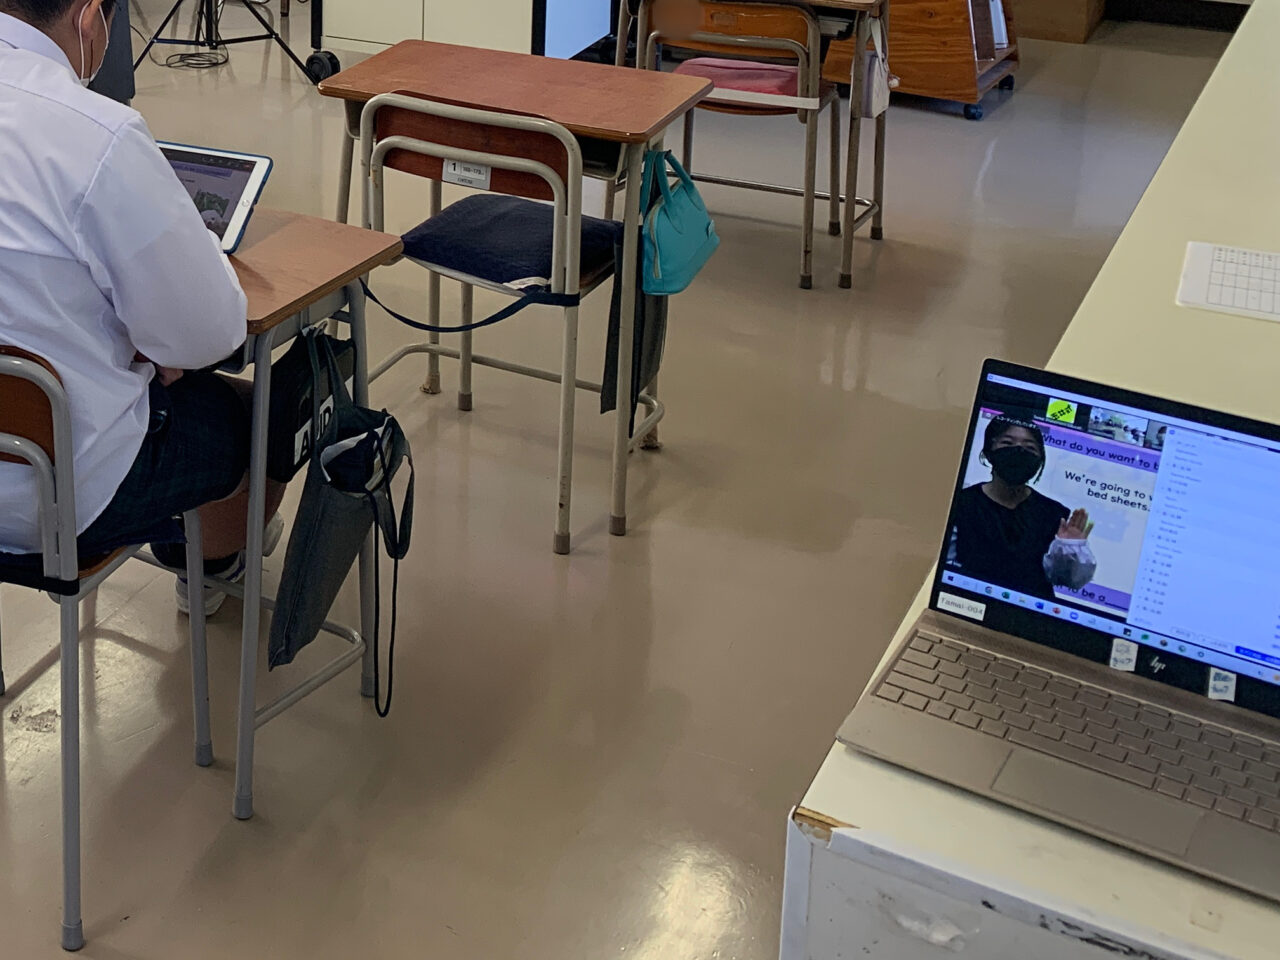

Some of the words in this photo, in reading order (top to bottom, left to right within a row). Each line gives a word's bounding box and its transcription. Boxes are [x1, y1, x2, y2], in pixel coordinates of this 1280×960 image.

[1070, 442, 1083, 451] do
[1086, 446, 1106, 457] you
[1108, 451, 1135, 464] want
[1139, 459, 1150, 468] to
[1065, 470, 1097, 486] We're
[1100, 482, 1131, 497] going
[1134, 490, 1146, 500] to
[1087, 488, 1108, 500] bed
[1111, 495, 1151, 512] sheets.
[1081, 588, 1095, 599] be
